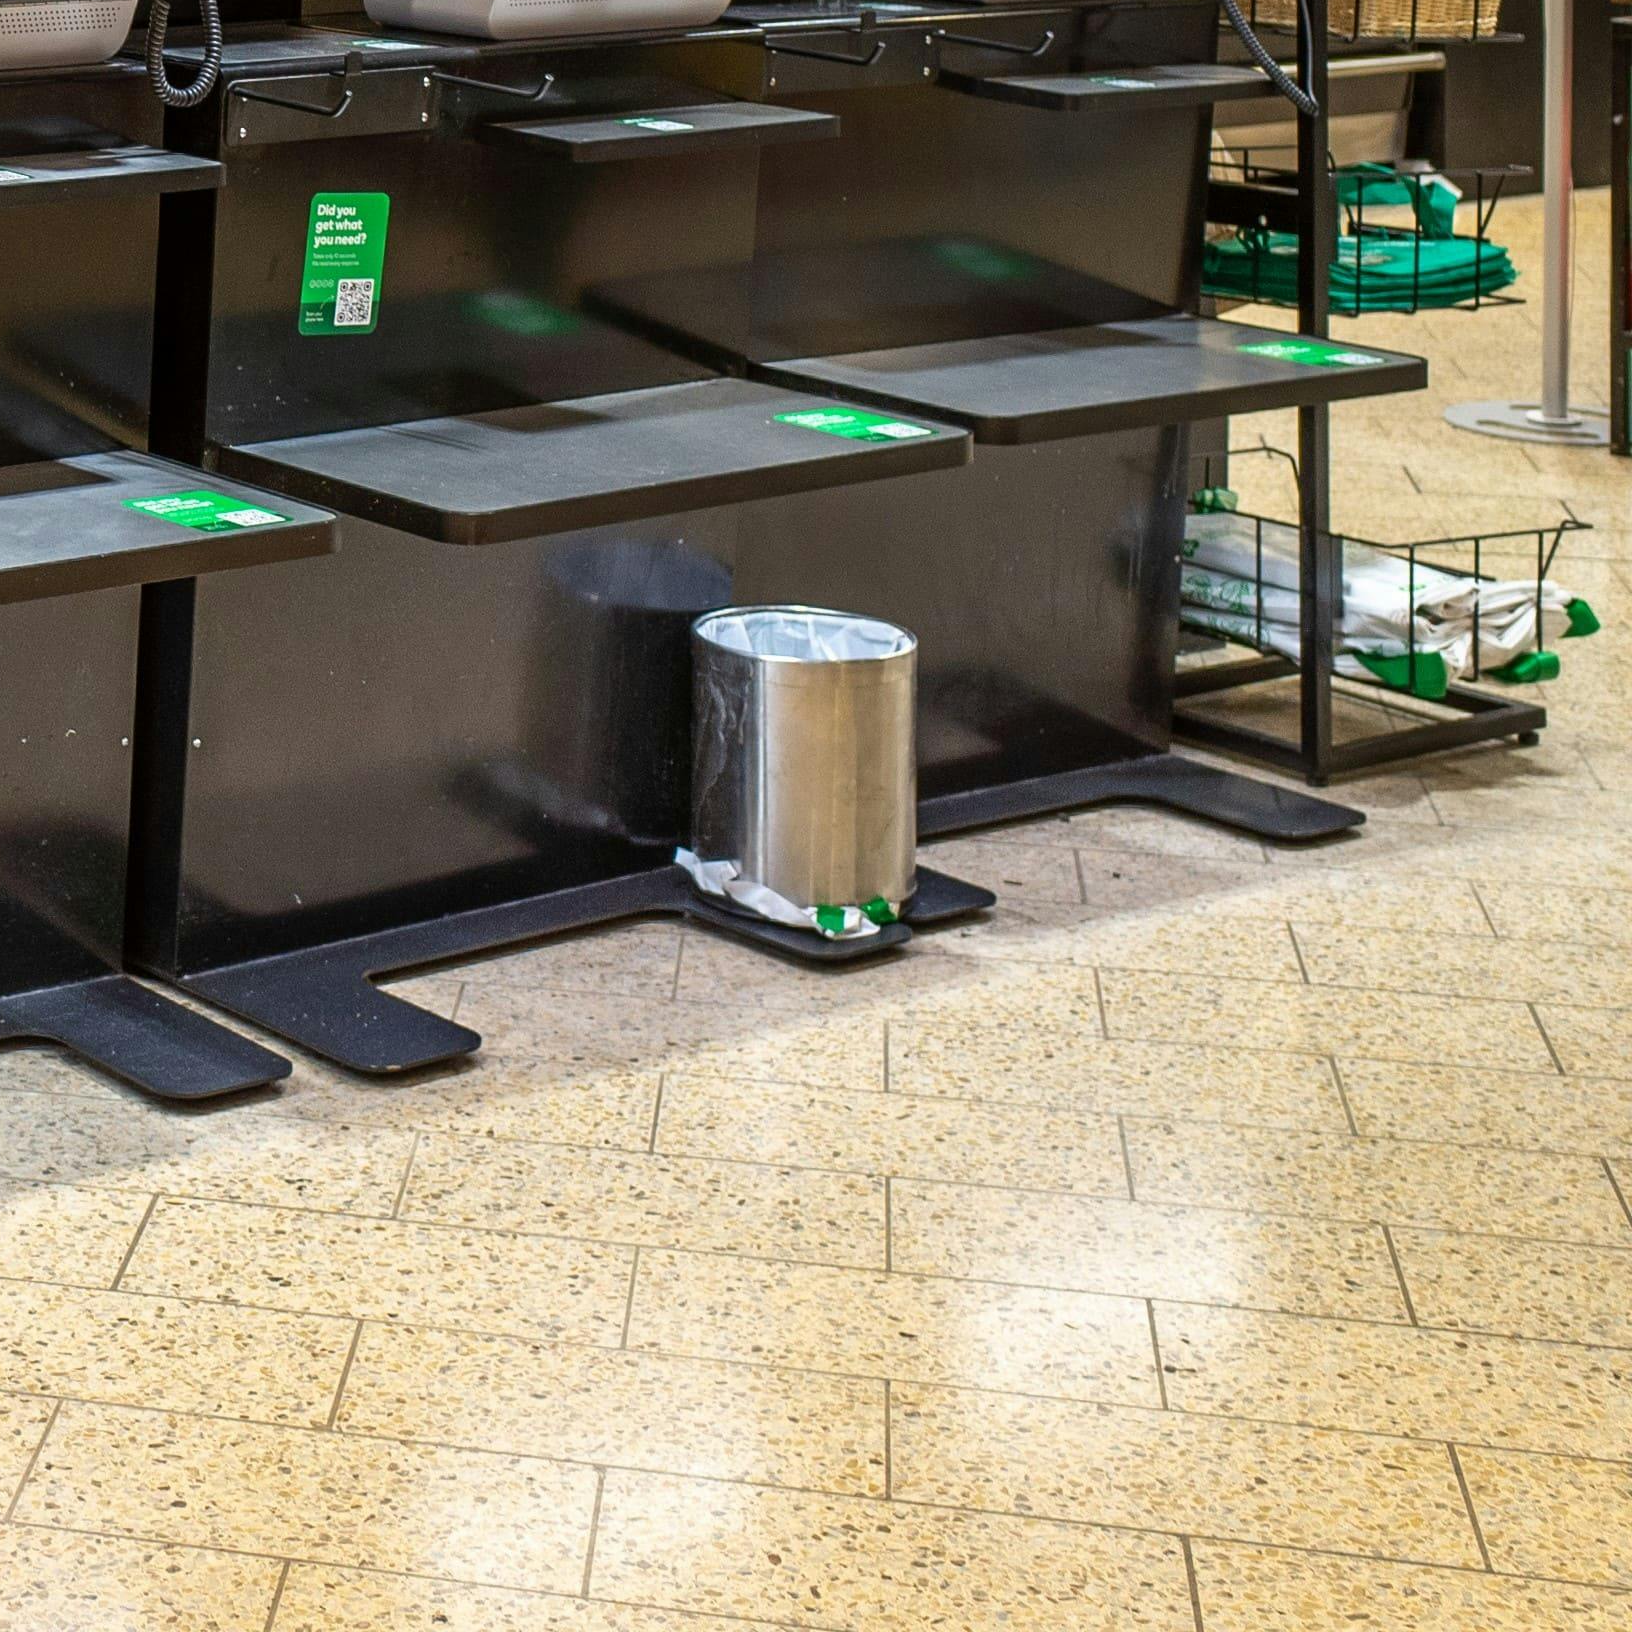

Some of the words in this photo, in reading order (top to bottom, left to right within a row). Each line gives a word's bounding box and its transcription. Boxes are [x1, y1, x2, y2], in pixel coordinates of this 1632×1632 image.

[317, 204, 336, 216] Did
[336, 205, 356, 218] you
[316, 220, 334, 234] get
[335, 219, 363, 231] what
[314, 235, 334, 249] you
[335, 233, 367, 245] need?
